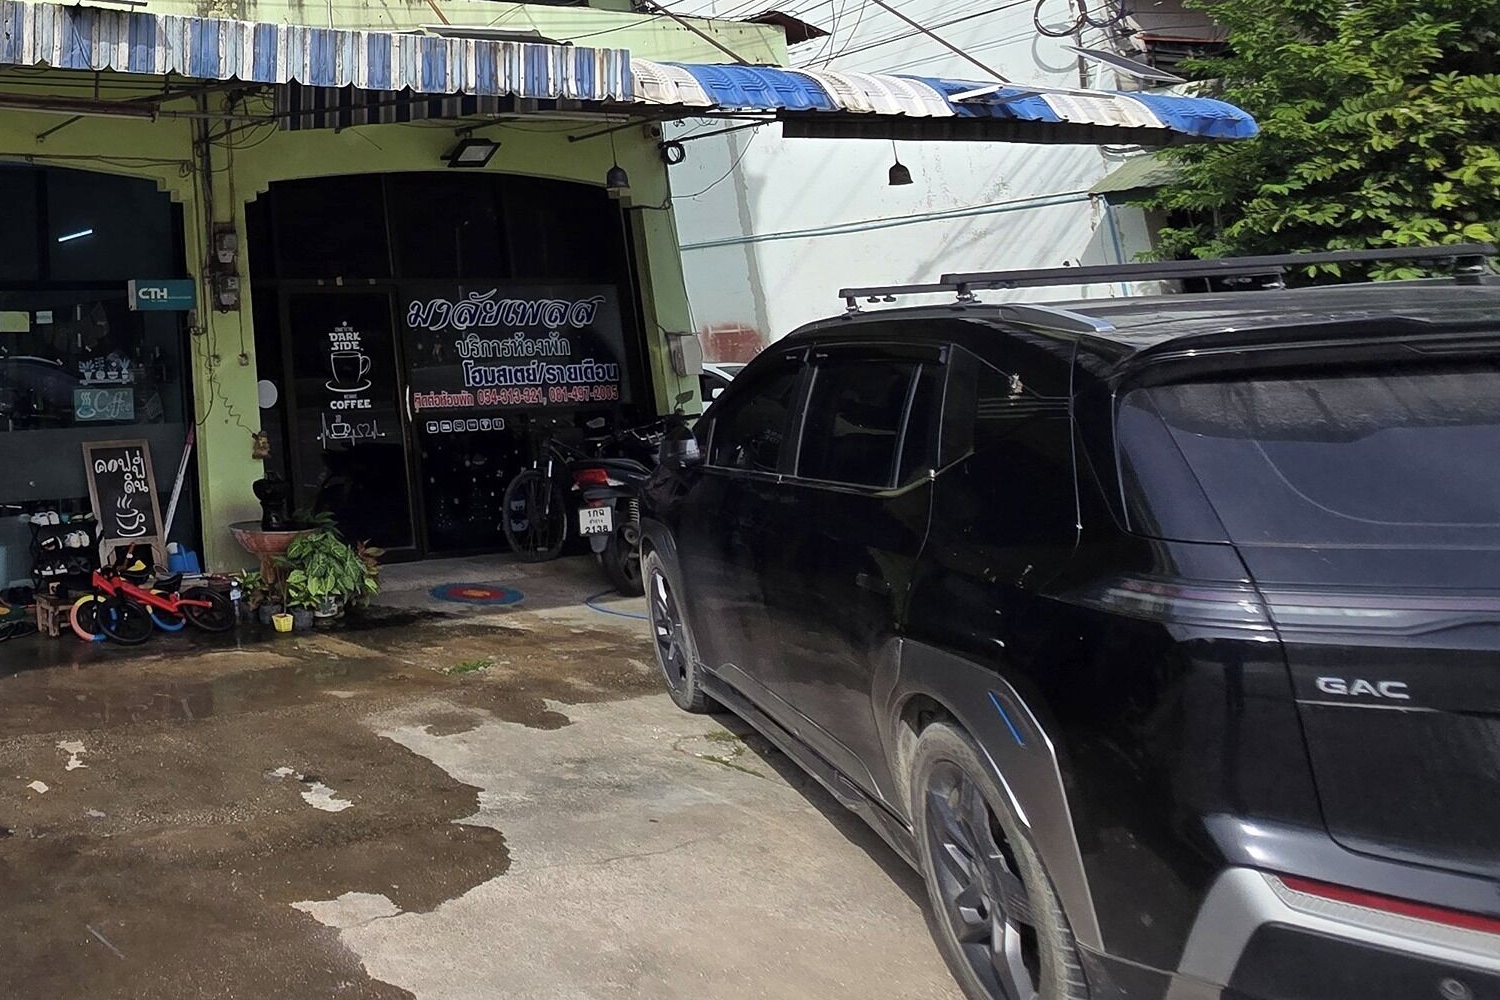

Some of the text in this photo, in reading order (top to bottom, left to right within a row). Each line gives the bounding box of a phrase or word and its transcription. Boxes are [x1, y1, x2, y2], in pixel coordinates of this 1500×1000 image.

[138, 287, 168, 300] CTH
[407, 288, 606, 331] มาลัยเพลส
[328, 332, 362, 342] DARK
[456, 332, 571, 358] บริการห้องพัก
[462, 358, 619, 387] โฮมสเตย์/รายเดือน
[330, 399, 372, 410] COFFEE
[549, 384, 619, 406] 081-497-2005
[1316, 677, 1410, 699] GAC
